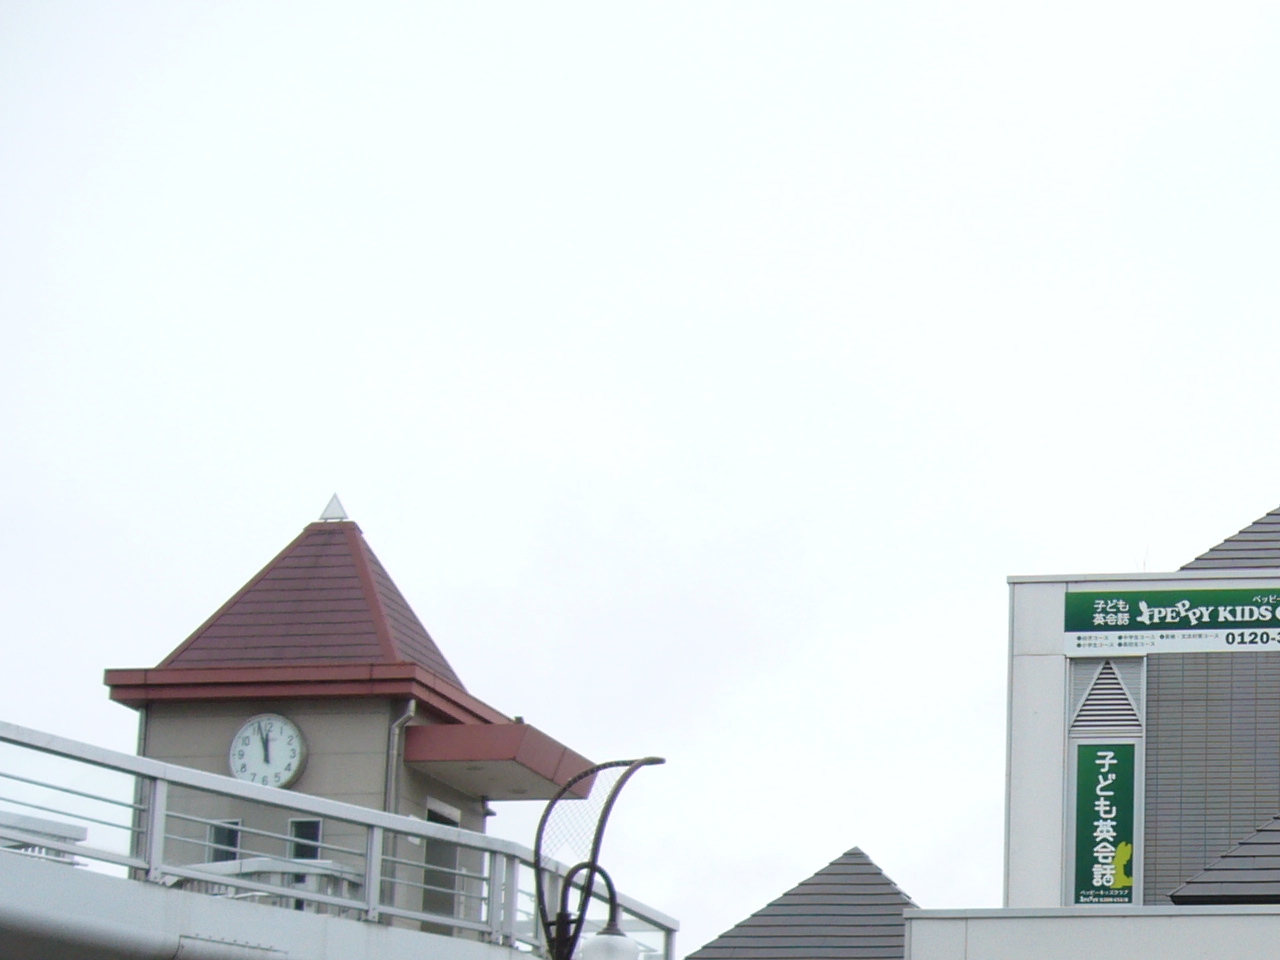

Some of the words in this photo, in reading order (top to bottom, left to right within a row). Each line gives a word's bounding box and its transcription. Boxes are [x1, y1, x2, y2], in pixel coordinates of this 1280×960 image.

[1093, 599, 1130, 612] 子ども
[1151, 599, 1214, 626] PEPPY
[1217, 605, 1273, 622] KIDS
[1092, 612, 1130, 626] 英会話
[241, 736, 250, 746] 10
[287, 735, 294, 745] 2
[238, 750, 244, 760] 9
[290, 749, 296, 758] 3
[284, 763, 291, 771] 4
[250, 773, 257, 782] 7
[274, 773, 281, 783] 5
[1092, 750, 1119, 887] 子ども英会話
